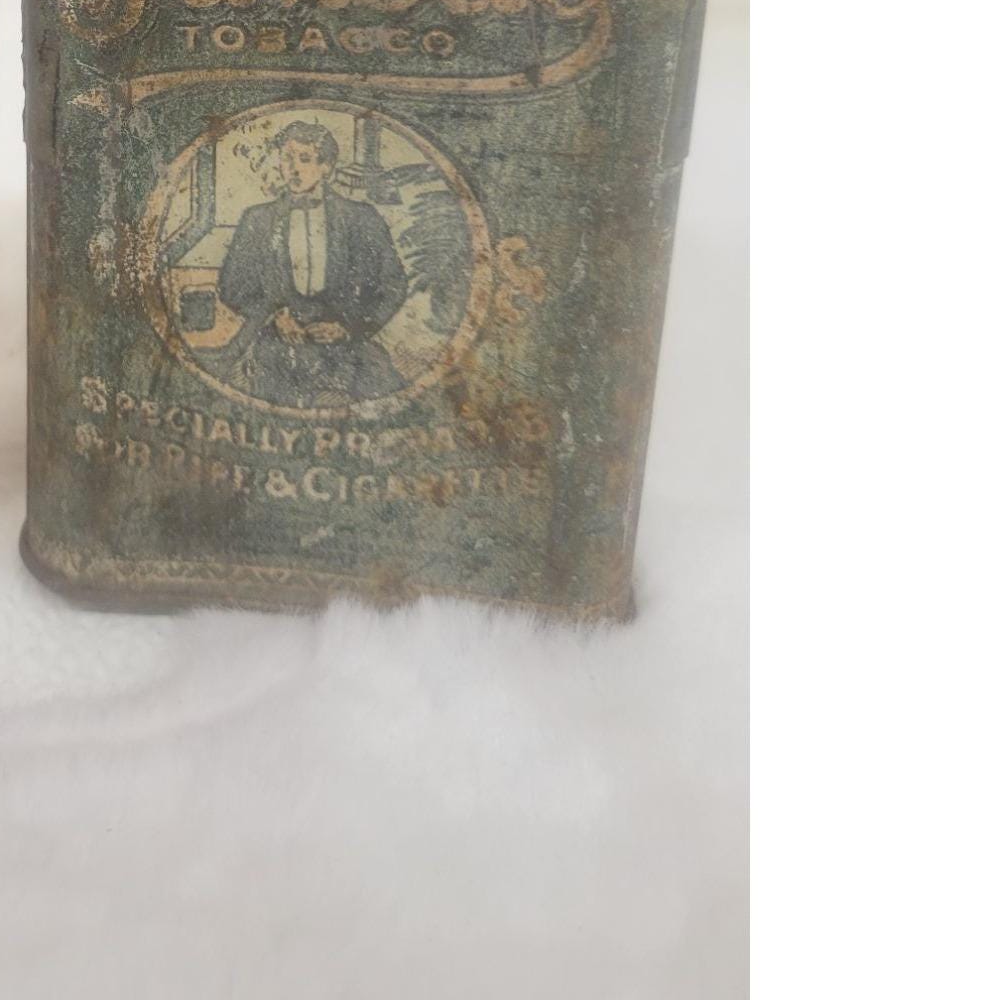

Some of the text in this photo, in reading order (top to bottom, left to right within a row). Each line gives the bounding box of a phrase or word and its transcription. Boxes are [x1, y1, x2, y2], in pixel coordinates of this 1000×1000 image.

[178, 24, 456, 56] TOBACCO
[80, 375, 301, 454] SPECIALLY
[264, 468, 298, 499] &
